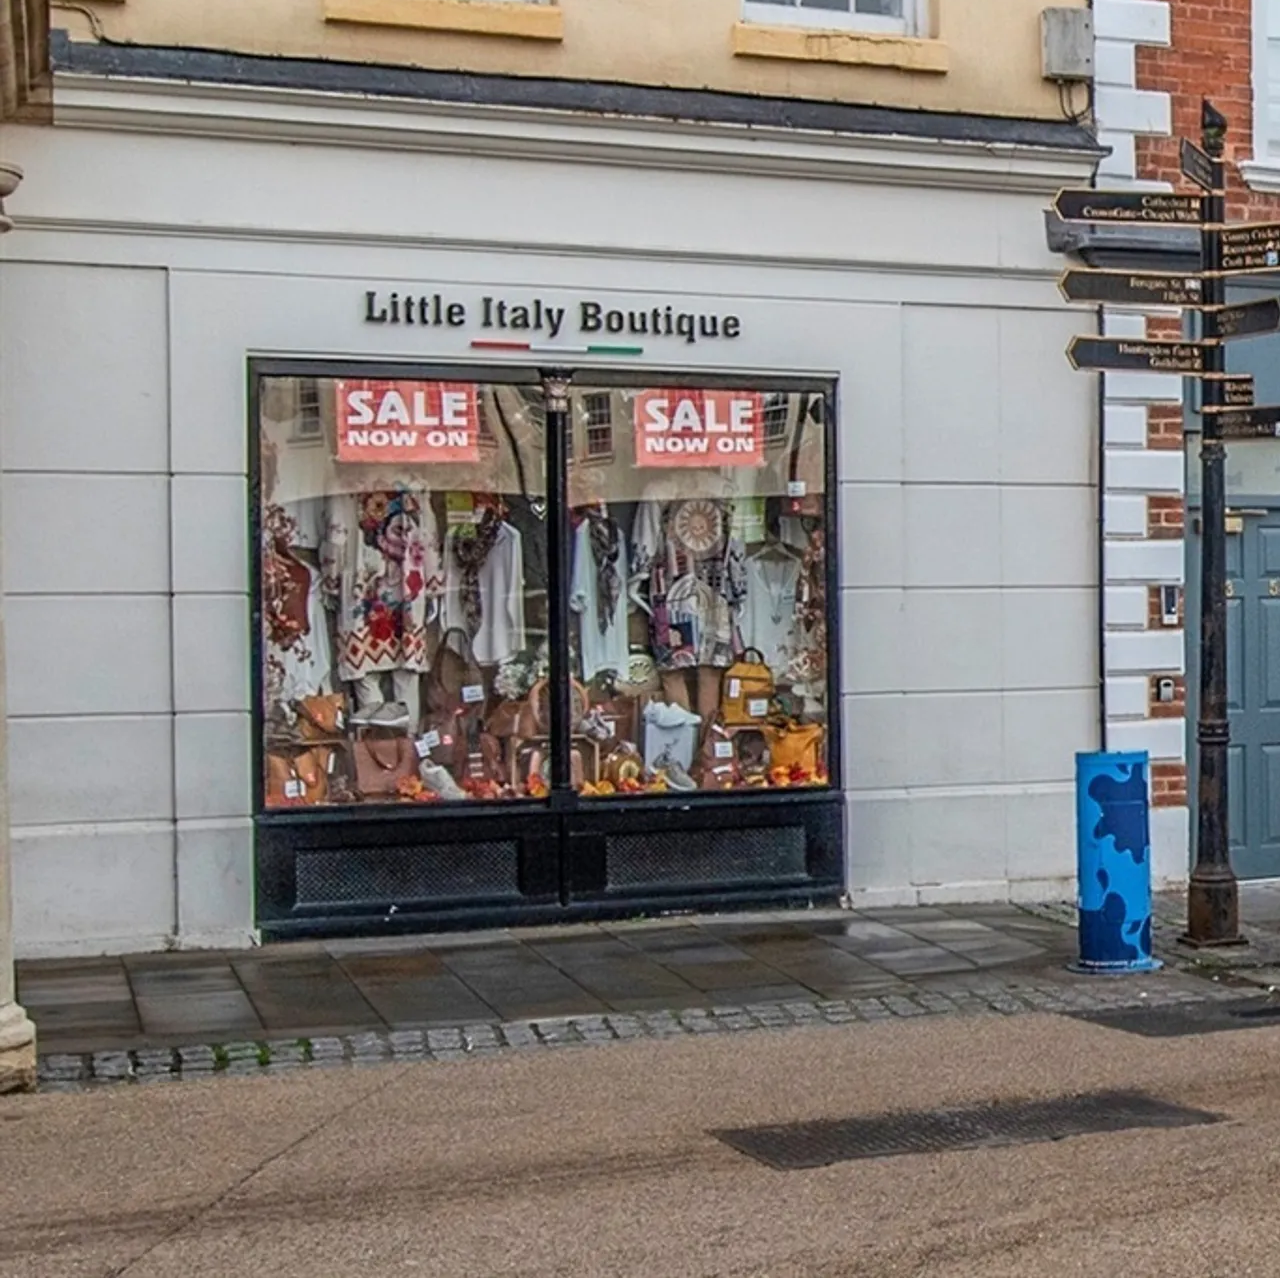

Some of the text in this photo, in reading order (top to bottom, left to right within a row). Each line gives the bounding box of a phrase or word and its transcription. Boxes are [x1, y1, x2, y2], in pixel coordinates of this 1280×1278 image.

[365, 290, 741, 344] Little Italy Boutique
[347, 390, 468, 426] SALE
[644, 398, 754, 433] SALE
[347, 430, 468, 447] NOW ON
[645, 437, 754, 453] NOW ON
